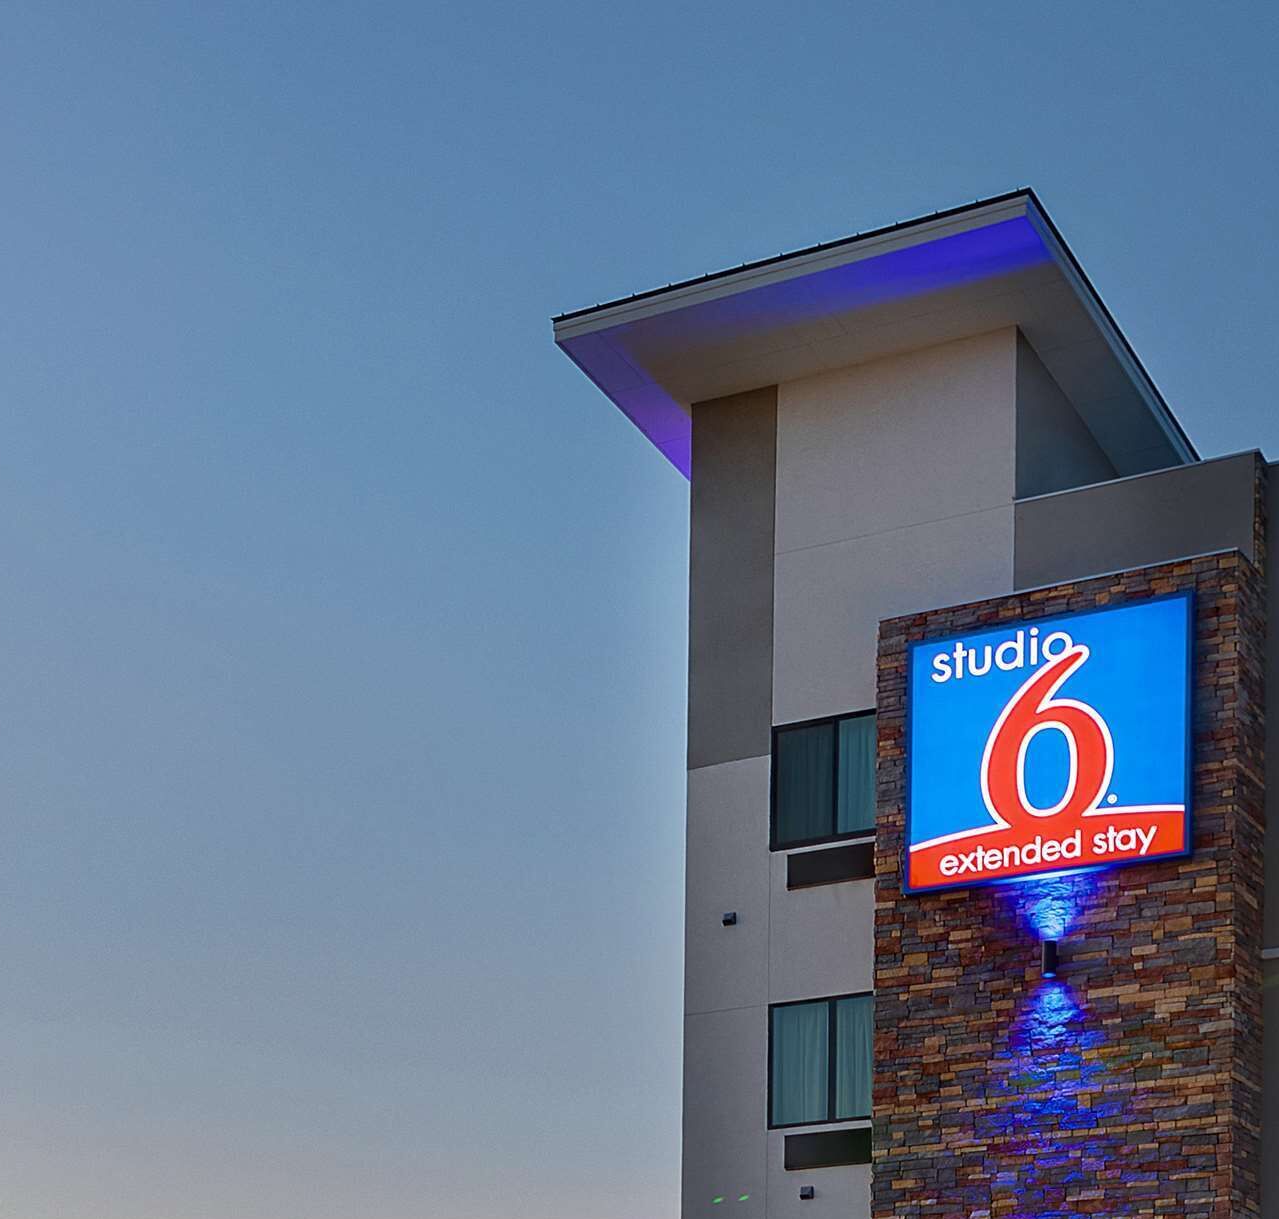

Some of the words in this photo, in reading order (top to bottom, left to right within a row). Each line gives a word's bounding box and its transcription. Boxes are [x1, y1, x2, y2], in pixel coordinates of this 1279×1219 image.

[931, 627, 1073, 683] studio
[980, 643, 1115, 829] 6
[939, 831, 1081, 876] extended
[1092, 825, 1157, 855] stay
